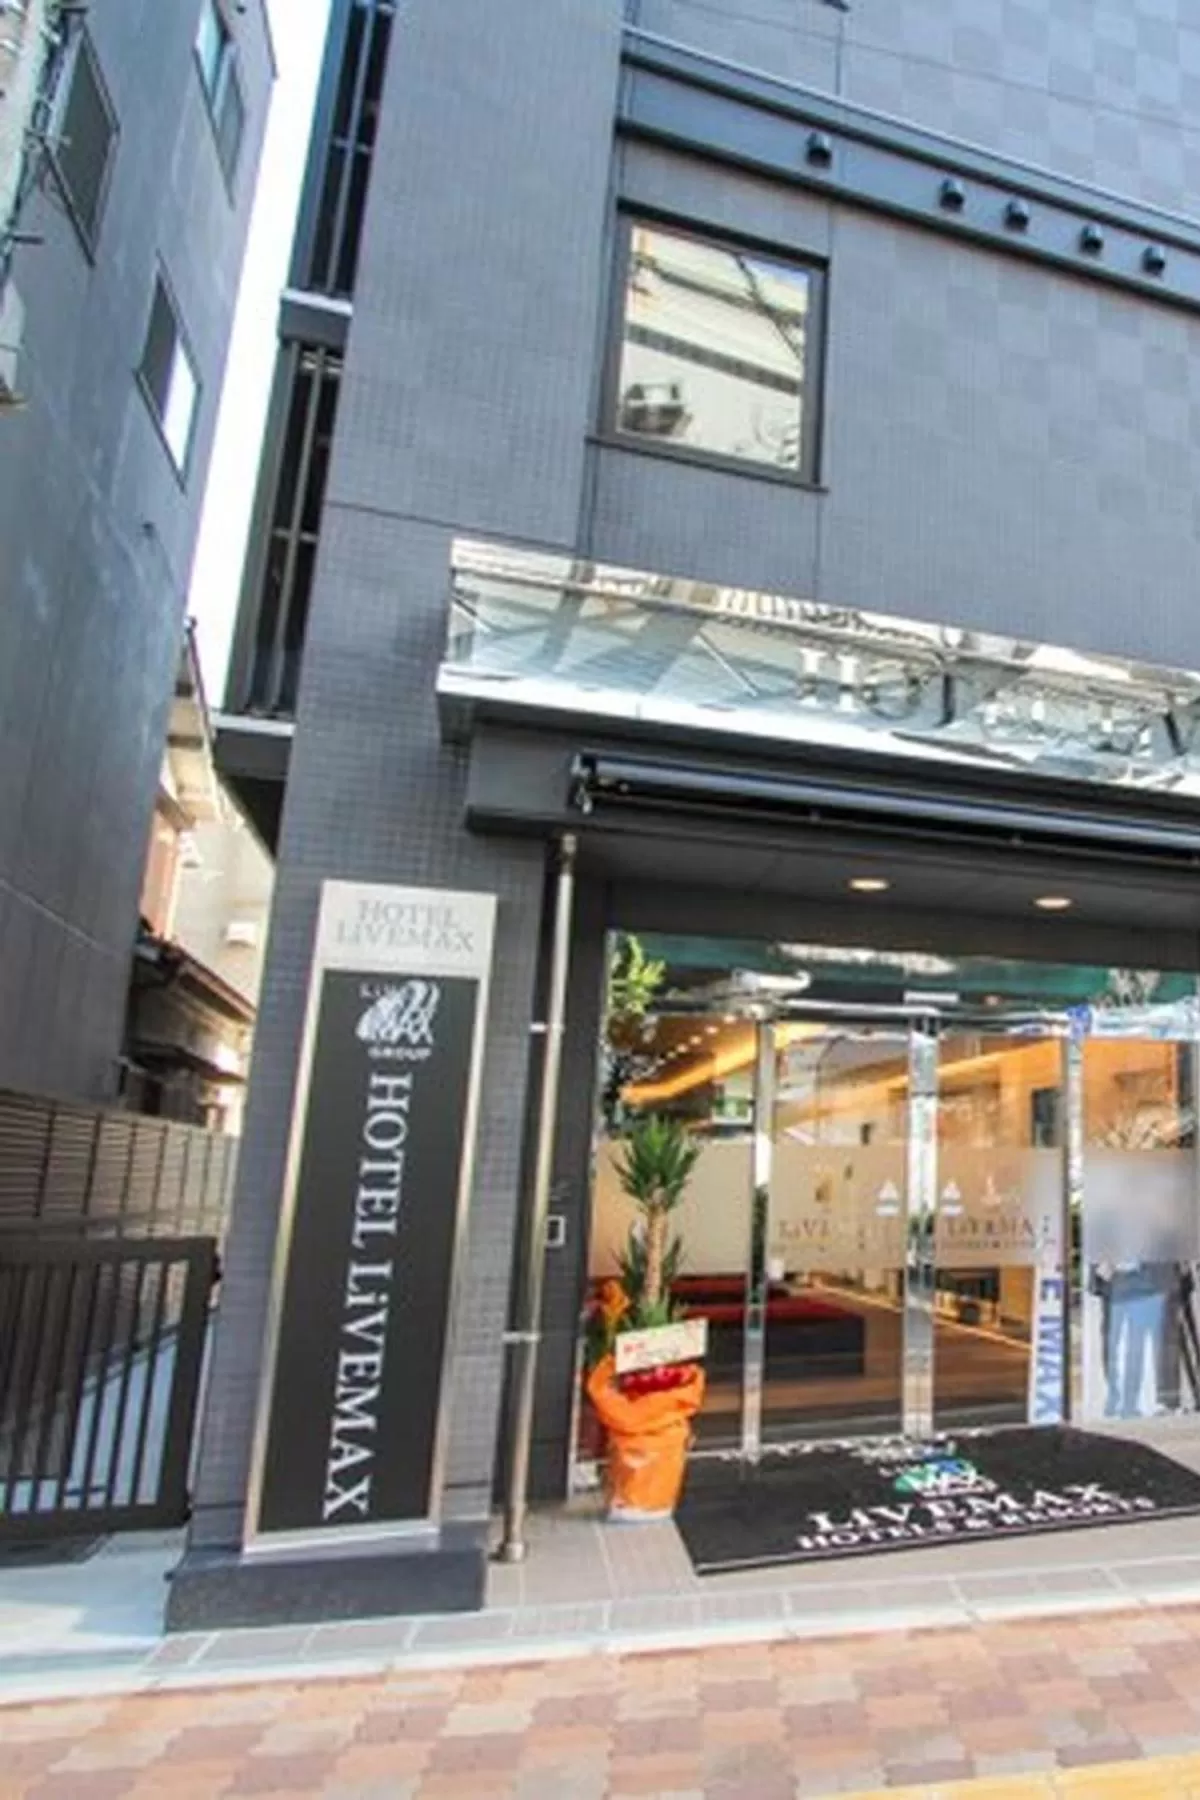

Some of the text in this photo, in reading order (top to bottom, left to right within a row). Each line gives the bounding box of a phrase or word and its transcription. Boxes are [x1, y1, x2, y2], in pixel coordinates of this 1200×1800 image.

[358, 899, 457, 927] HOTEL
[351, 1071, 414, 1248] HOTEL
[797, 1517, 954, 1549] HOTELS
